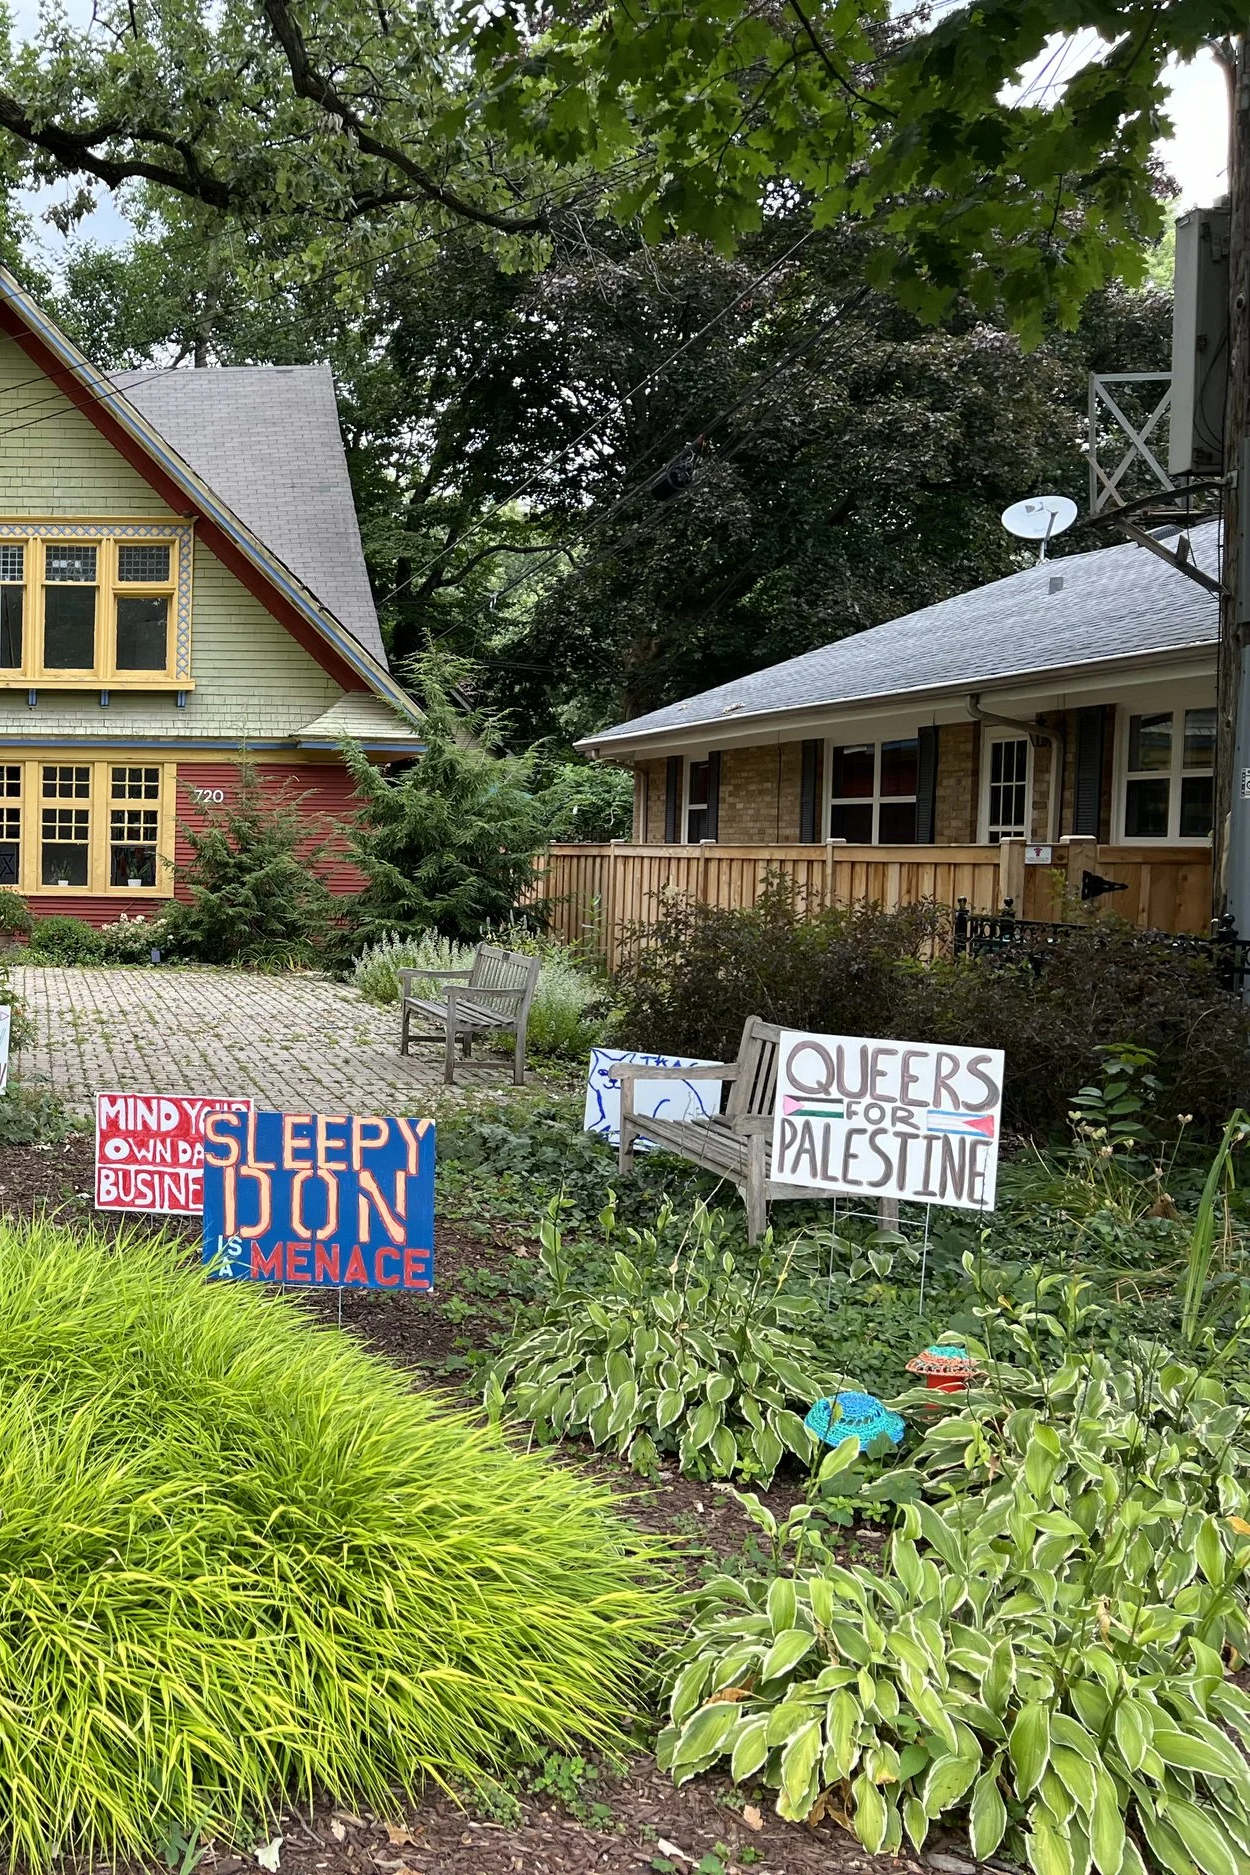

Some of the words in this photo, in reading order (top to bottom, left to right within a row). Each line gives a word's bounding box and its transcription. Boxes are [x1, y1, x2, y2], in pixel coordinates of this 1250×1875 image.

[193, 789, 224, 804] 720
[786, 1040, 1000, 1112] QUEERS
[100, 1096, 180, 1132] MIND
[846, 1101, 921, 1131] FOR
[104, 1137, 172, 1164] OWN
[204, 1111, 435, 1175] SLEEPY
[777, 1117, 993, 1206] PALESTINE
[223, 1165, 407, 1245] DON
[218, 1234, 243, 1257] IS
[218, 1257, 233, 1277] A
[250, 1239, 430, 1289] MENACE
